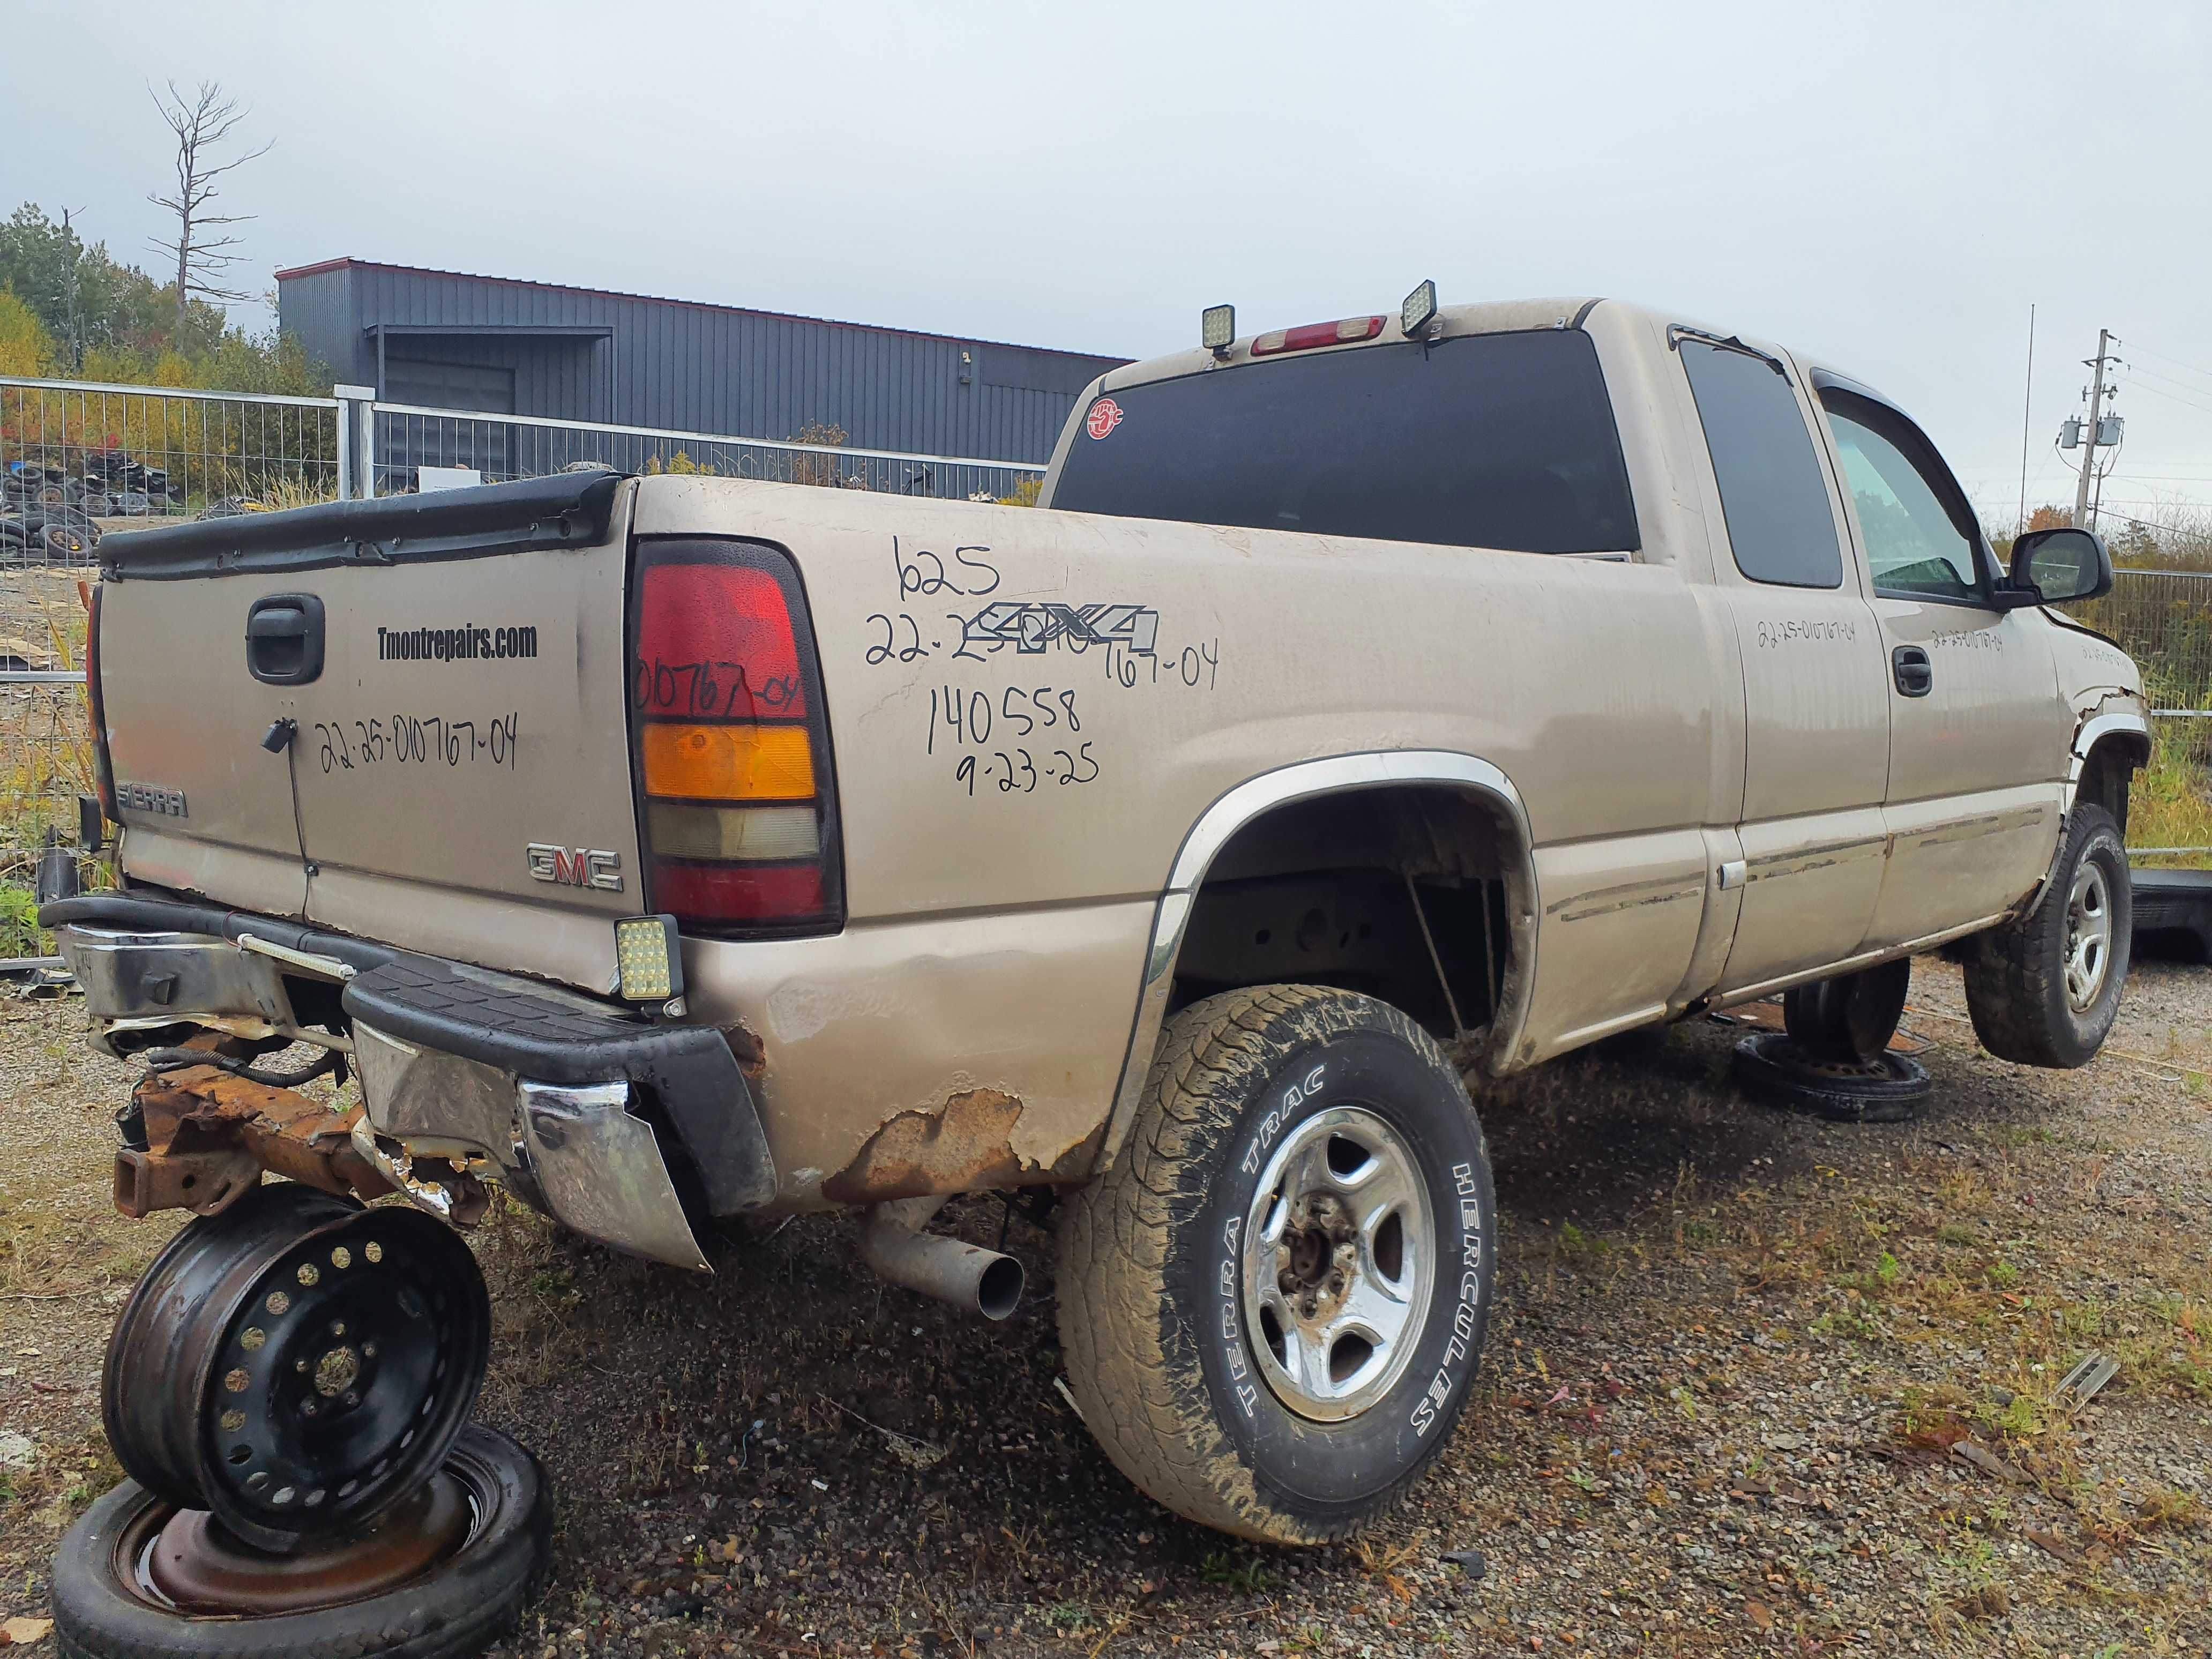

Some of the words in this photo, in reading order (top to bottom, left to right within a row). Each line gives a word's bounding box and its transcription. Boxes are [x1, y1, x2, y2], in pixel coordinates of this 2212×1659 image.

[377, 623, 537, 663] Tmontrepairs.com
[927, 685, 1081, 755] 140558
[115, 780, 189, 818] SIERRA
[526, 842, 624, 893] GMC
[1221, 1215, 1258, 1419] TERRA
[1242, 1065, 1326, 1175] TRAC
[1409, 1162, 1481, 1437] HERCULES
